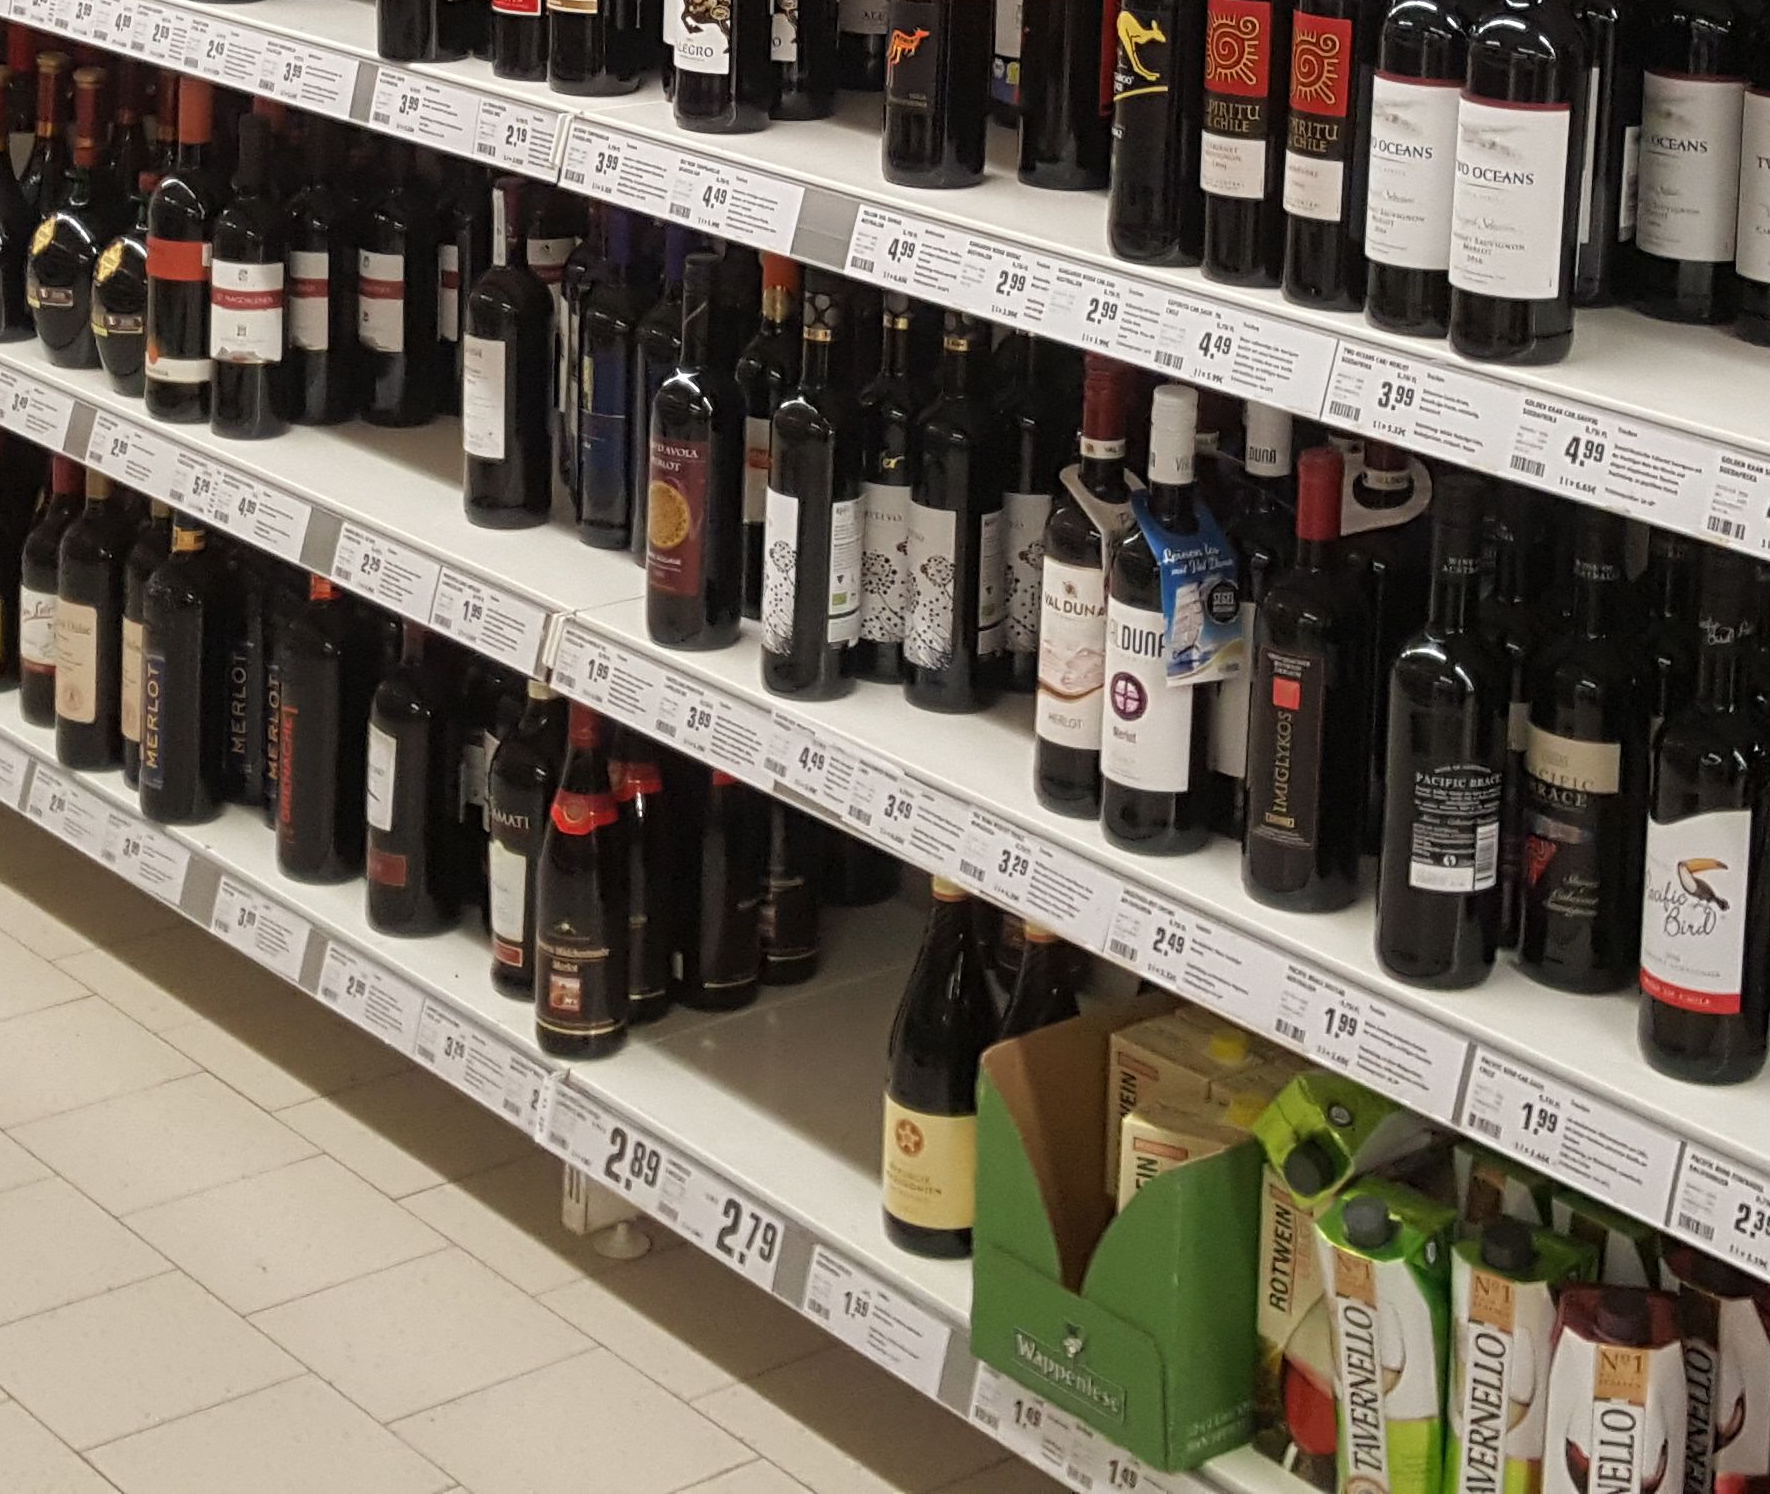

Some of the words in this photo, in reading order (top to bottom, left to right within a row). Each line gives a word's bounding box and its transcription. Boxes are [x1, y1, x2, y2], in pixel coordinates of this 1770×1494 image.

[595, 152, 619, 175] 3.99
[1377, 140, 1433, 160] OCEANS
[1472, 165, 1534, 186] OCEANS
[702, 185, 727, 209] 4.49
[888, 237, 916, 263] 4.99
[996, 269, 1026, 296] 2.99
[1086, 297, 1118, 325] 2.99
[1198, 331, 1232, 360] 4.49
[1377, 381, 1415, 411] 3.99
[1564, 435, 1605, 467] 4.99
[147, 662, 160, 769] MERLOT
[884, 792, 913, 823] 3.49
[997, 847, 1031, 878] 3.29
[1663, 908, 1717, 937] Bird
[1151, 925, 1186, 957] 2.49
[1324, 1006, 1357, 1040] 1.99
[1522, 1101, 1558, 1137] 1.99
[603, 1125, 662, 1192] 2.89
[716, 1196, 779, 1267] 2.79
[1270, 1205, 1294, 1313] ROTWEIN
[1348, 1304, 1383, 1474] TAVERNELLO
[1460, 1330, 1507, 1494] AVERNELLO
